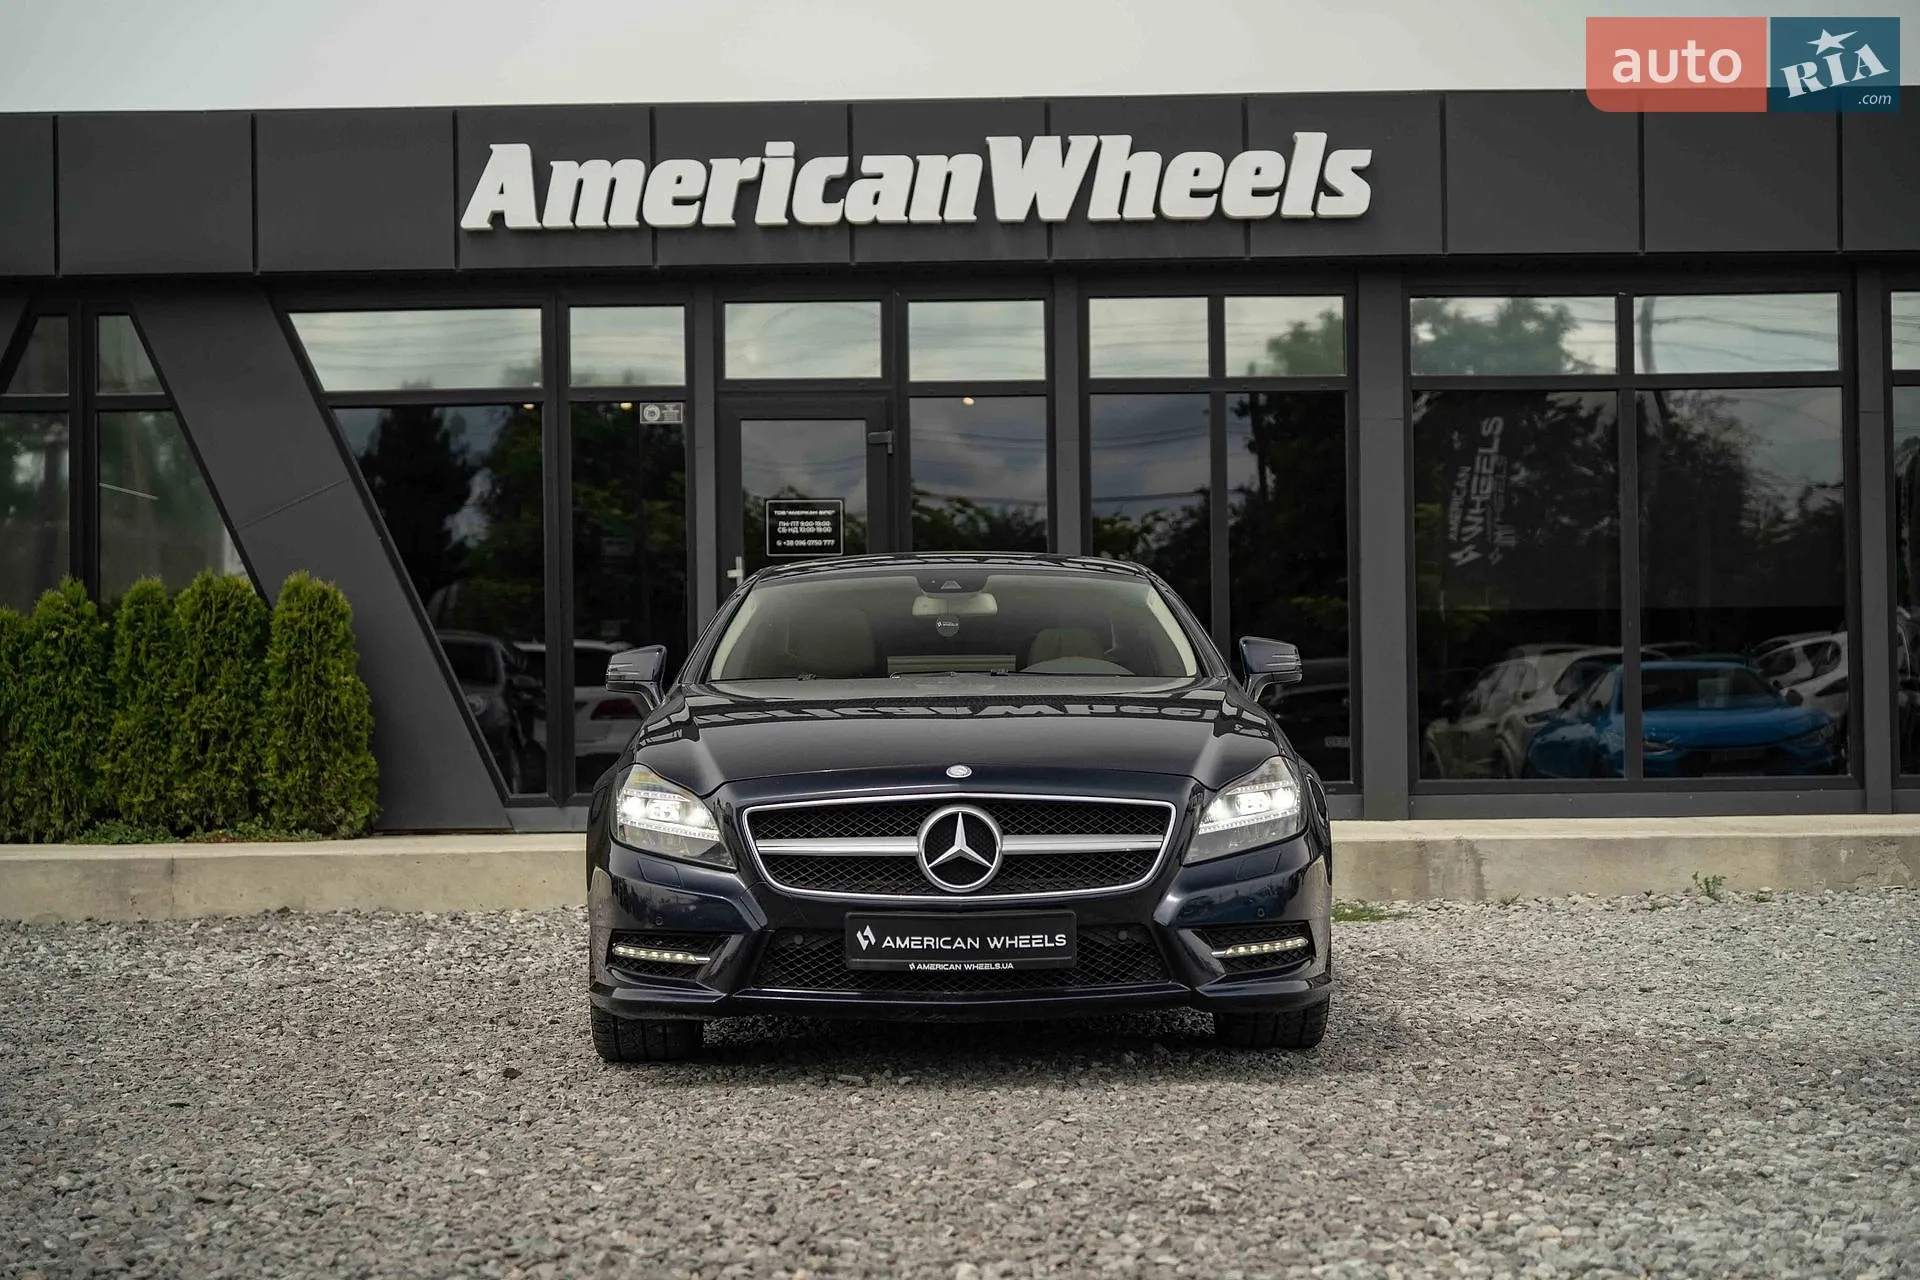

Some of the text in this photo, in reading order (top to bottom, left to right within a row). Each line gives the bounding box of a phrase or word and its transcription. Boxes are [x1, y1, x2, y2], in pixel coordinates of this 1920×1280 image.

[1461, 416, 1504, 543] WHEELS
[881, 934, 1067, 949] AMERICAN WHEELS
[916, 962, 1014, 971] AMERICAN WHEELS.UA
